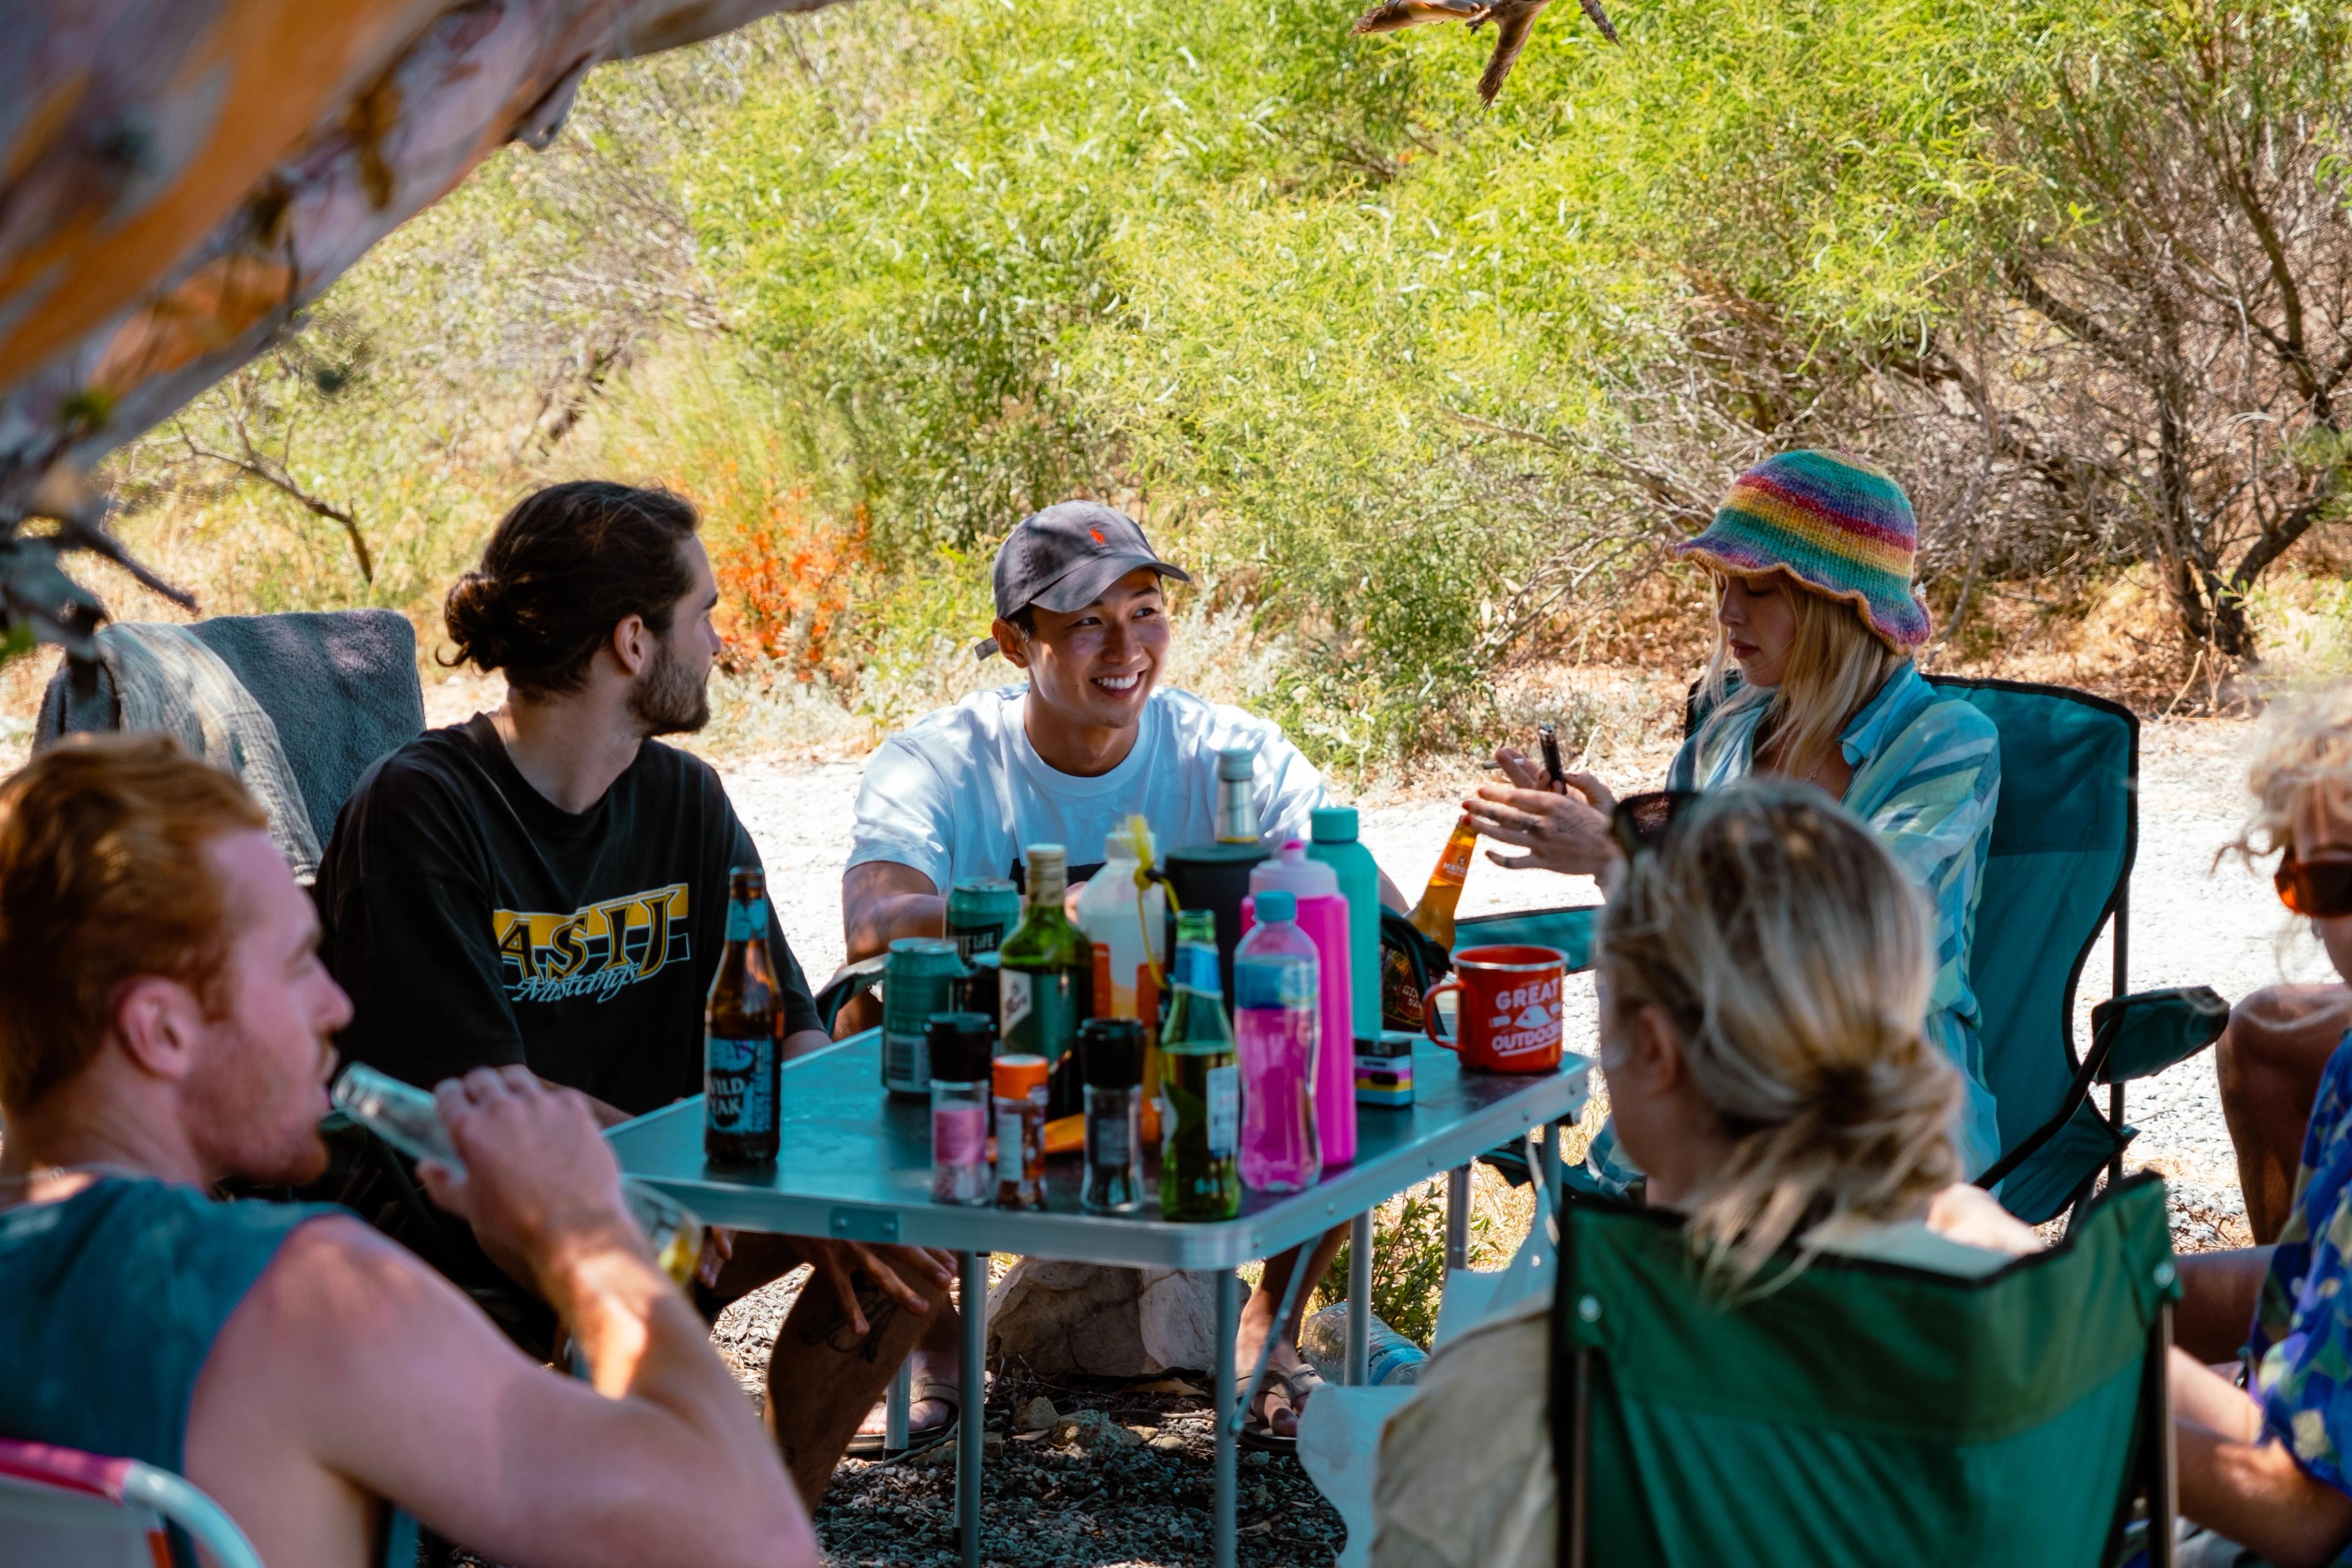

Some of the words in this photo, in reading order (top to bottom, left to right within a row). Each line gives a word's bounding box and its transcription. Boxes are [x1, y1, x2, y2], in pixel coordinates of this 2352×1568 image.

[499, 889, 681, 983] ASIJ
[511, 962, 641, 1004] Mustangs
[1495, 977, 1559, 1010] GREAT
